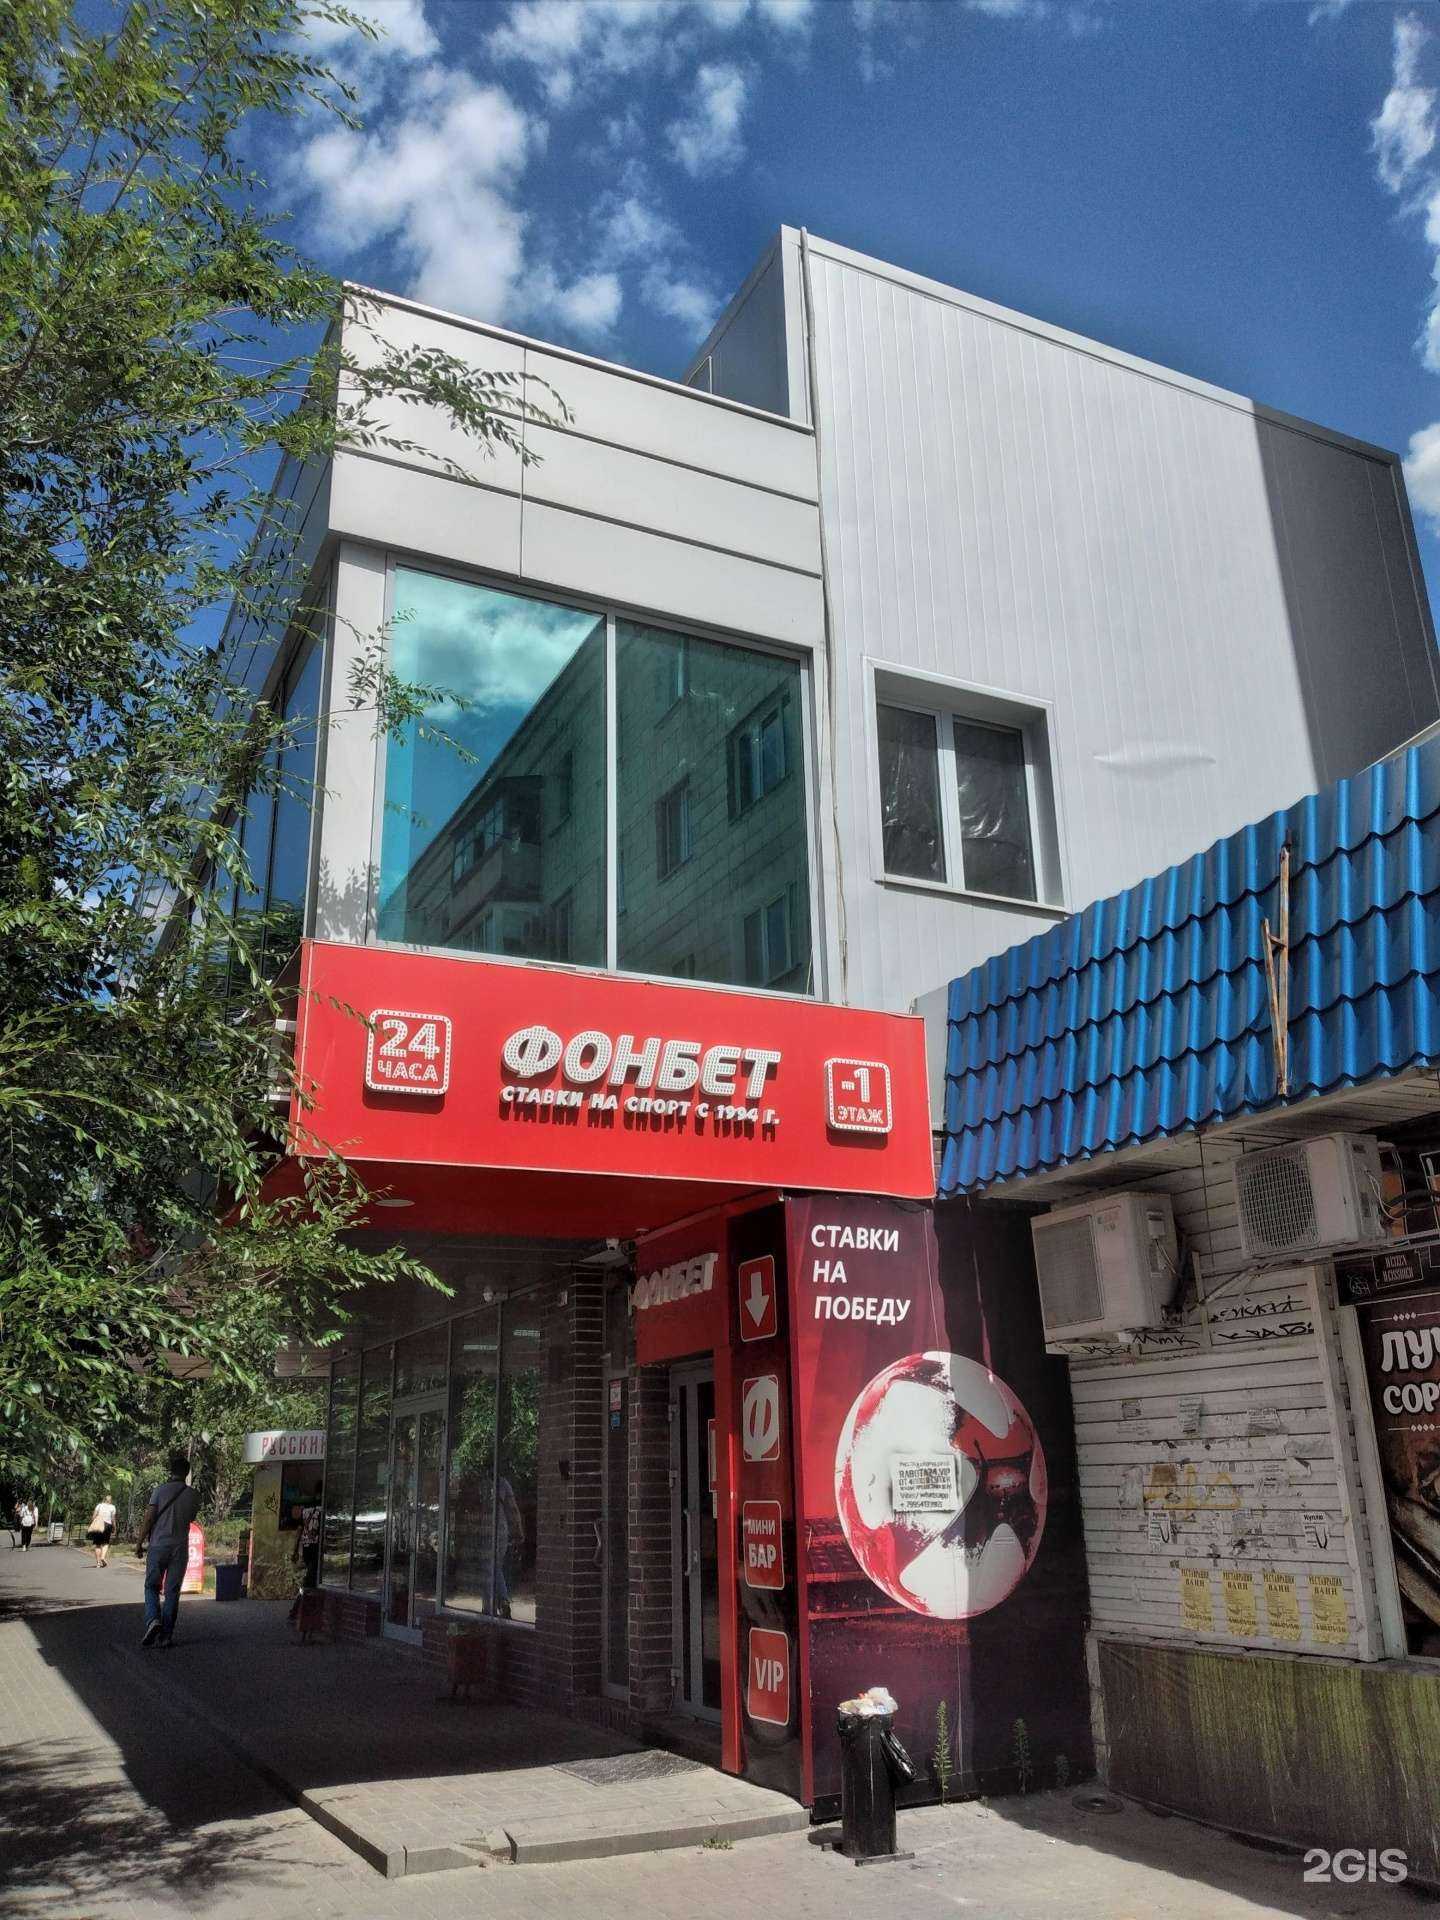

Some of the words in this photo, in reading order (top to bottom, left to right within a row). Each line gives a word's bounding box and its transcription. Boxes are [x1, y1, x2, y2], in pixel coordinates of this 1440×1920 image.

[380, 1019, 440, 1060] 24
[378, 1060, 438, 1082] ЧАСА
[502, 1026, 781, 1099] ФОНБЕТ
[841, 1067, 870, 1103] -1
[501, 1085, 583, 1107] СТАВКИ
[591, 1093, 618, 1110] НА
[625, 1096, 691, 1117] СПОРТ
[696, 1103, 709, 1118] С
[716, 1104, 759, 1122] 1994
[838, 1105, 884, 1124] ЭТАЖ
[811, 1224, 899, 1252] СТАВКИ
[813, 1260, 847, 1284] НА
[815, 1296, 911, 1326] ПОБЕДУ
[1383, 1382, 1440, 1414] СОР
[748, 1519, 776, 1535] МИНИ
[748, 1543, 776, 1568] БАР
[755, 1657, 784, 1693] VIP
